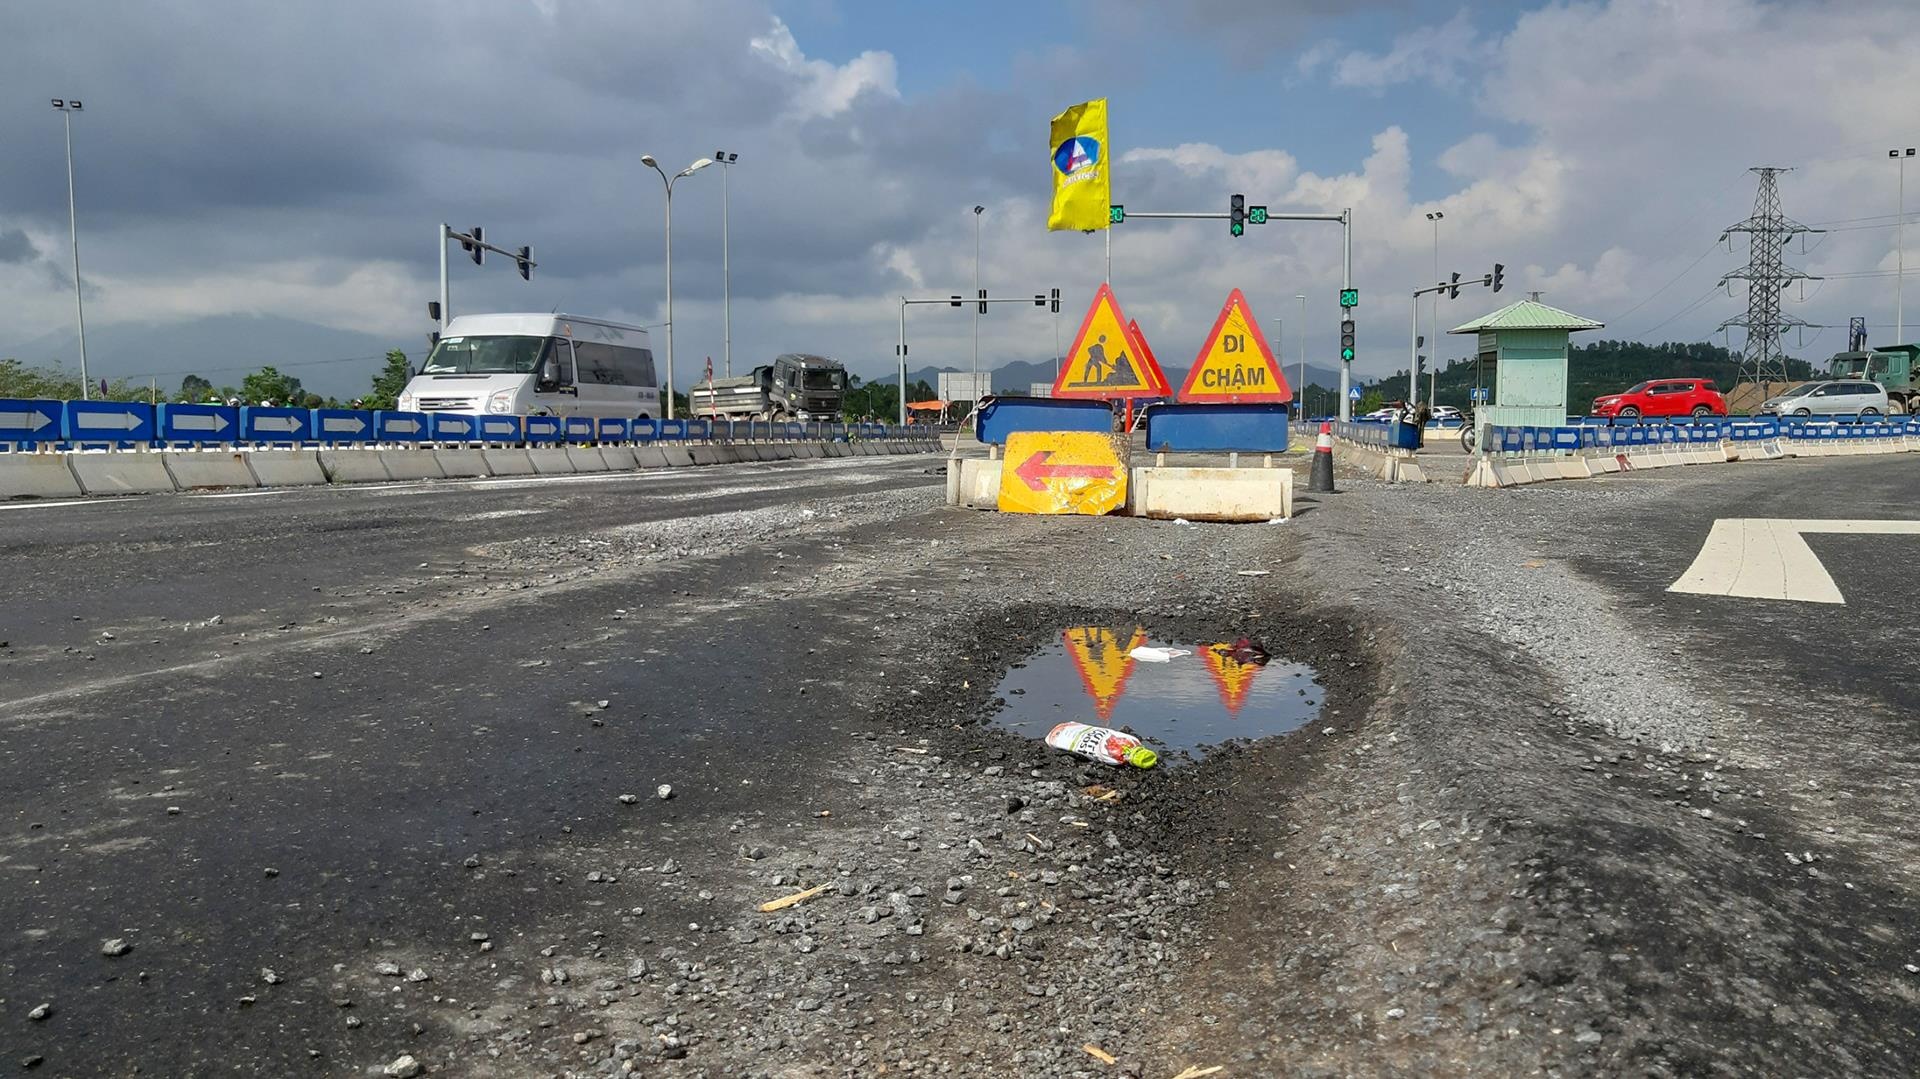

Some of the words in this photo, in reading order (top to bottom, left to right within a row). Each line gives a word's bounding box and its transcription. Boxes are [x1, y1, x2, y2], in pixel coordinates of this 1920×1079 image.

[1250, 208, 1265, 222] 20
[1341, 291, 1356, 305] 20
[1223, 334, 1245, 353] ĐI
[1202, 364, 1265, 390] CHẬM
